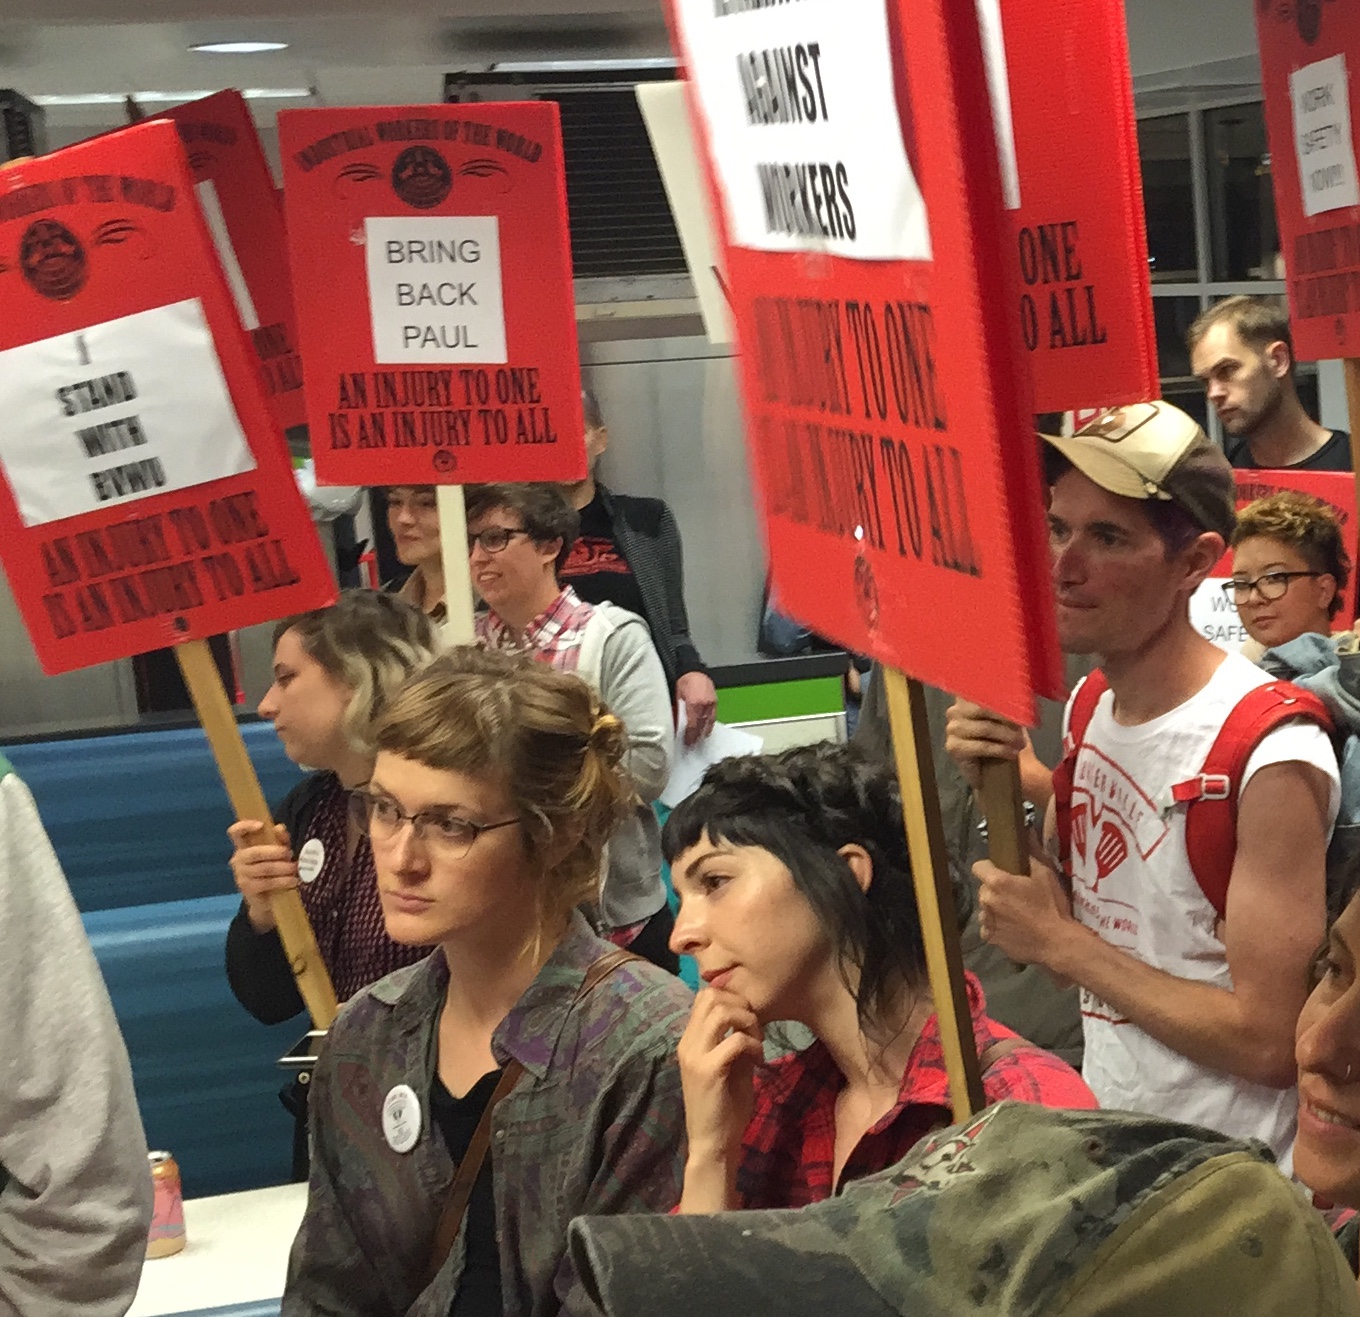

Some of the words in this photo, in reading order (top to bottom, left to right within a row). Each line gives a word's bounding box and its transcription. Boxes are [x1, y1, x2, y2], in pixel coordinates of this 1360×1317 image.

[737, 42, 828, 126] AGAINST
[755, 160, 856, 243] WORKERS
[387, 239, 480, 264] BRING
[1019, 221, 1082, 285] ONE
[397, 283, 478, 306] BACK
[1020, 293, 1039, 351] O
[1050, 285, 1108, 349] ALL
[403, 325, 478, 348] PAUL
[846, 301, 887, 421] TO
[885, 301, 947, 432] ONE
[338, 373, 367, 409] AN
[373, 370, 452, 407] INJURY
[459, 369, 489, 405] TO
[496, 368, 541, 404] ONE
[328, 412, 351, 449] IS
[358, 412, 386, 448] AN
[392, 410, 471, 447] INJURY
[478, 409, 508, 445] TO
[515, 407, 557, 444] ALL
[880, 436, 922, 561] TO
[922, 444, 983, 579] ALL
